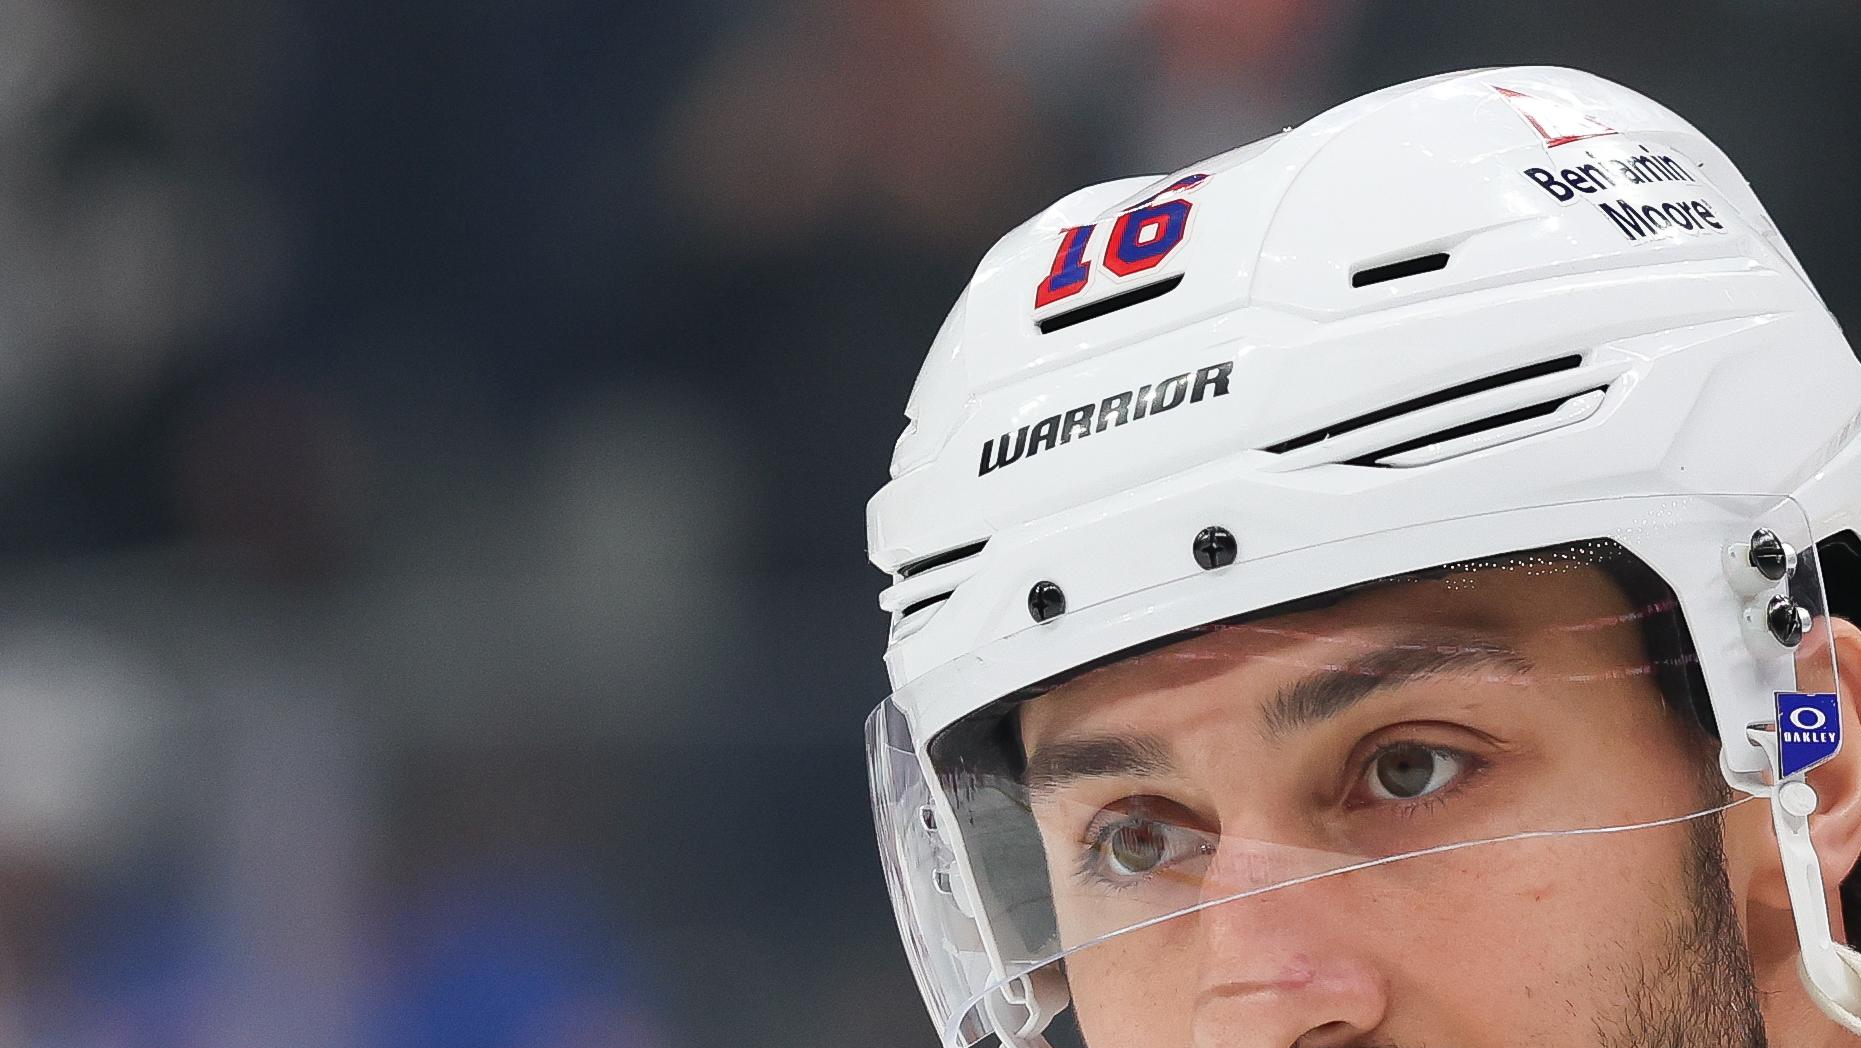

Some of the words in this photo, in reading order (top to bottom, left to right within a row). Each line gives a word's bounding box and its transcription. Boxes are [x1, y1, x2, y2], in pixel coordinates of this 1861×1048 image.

[1034, 173, 1215, 309] 16
[1597, 198, 1724, 241] Moore
[978, 360, 1235, 478] WARRIOR
[1783, 731, 1836, 744] OAKLEY
